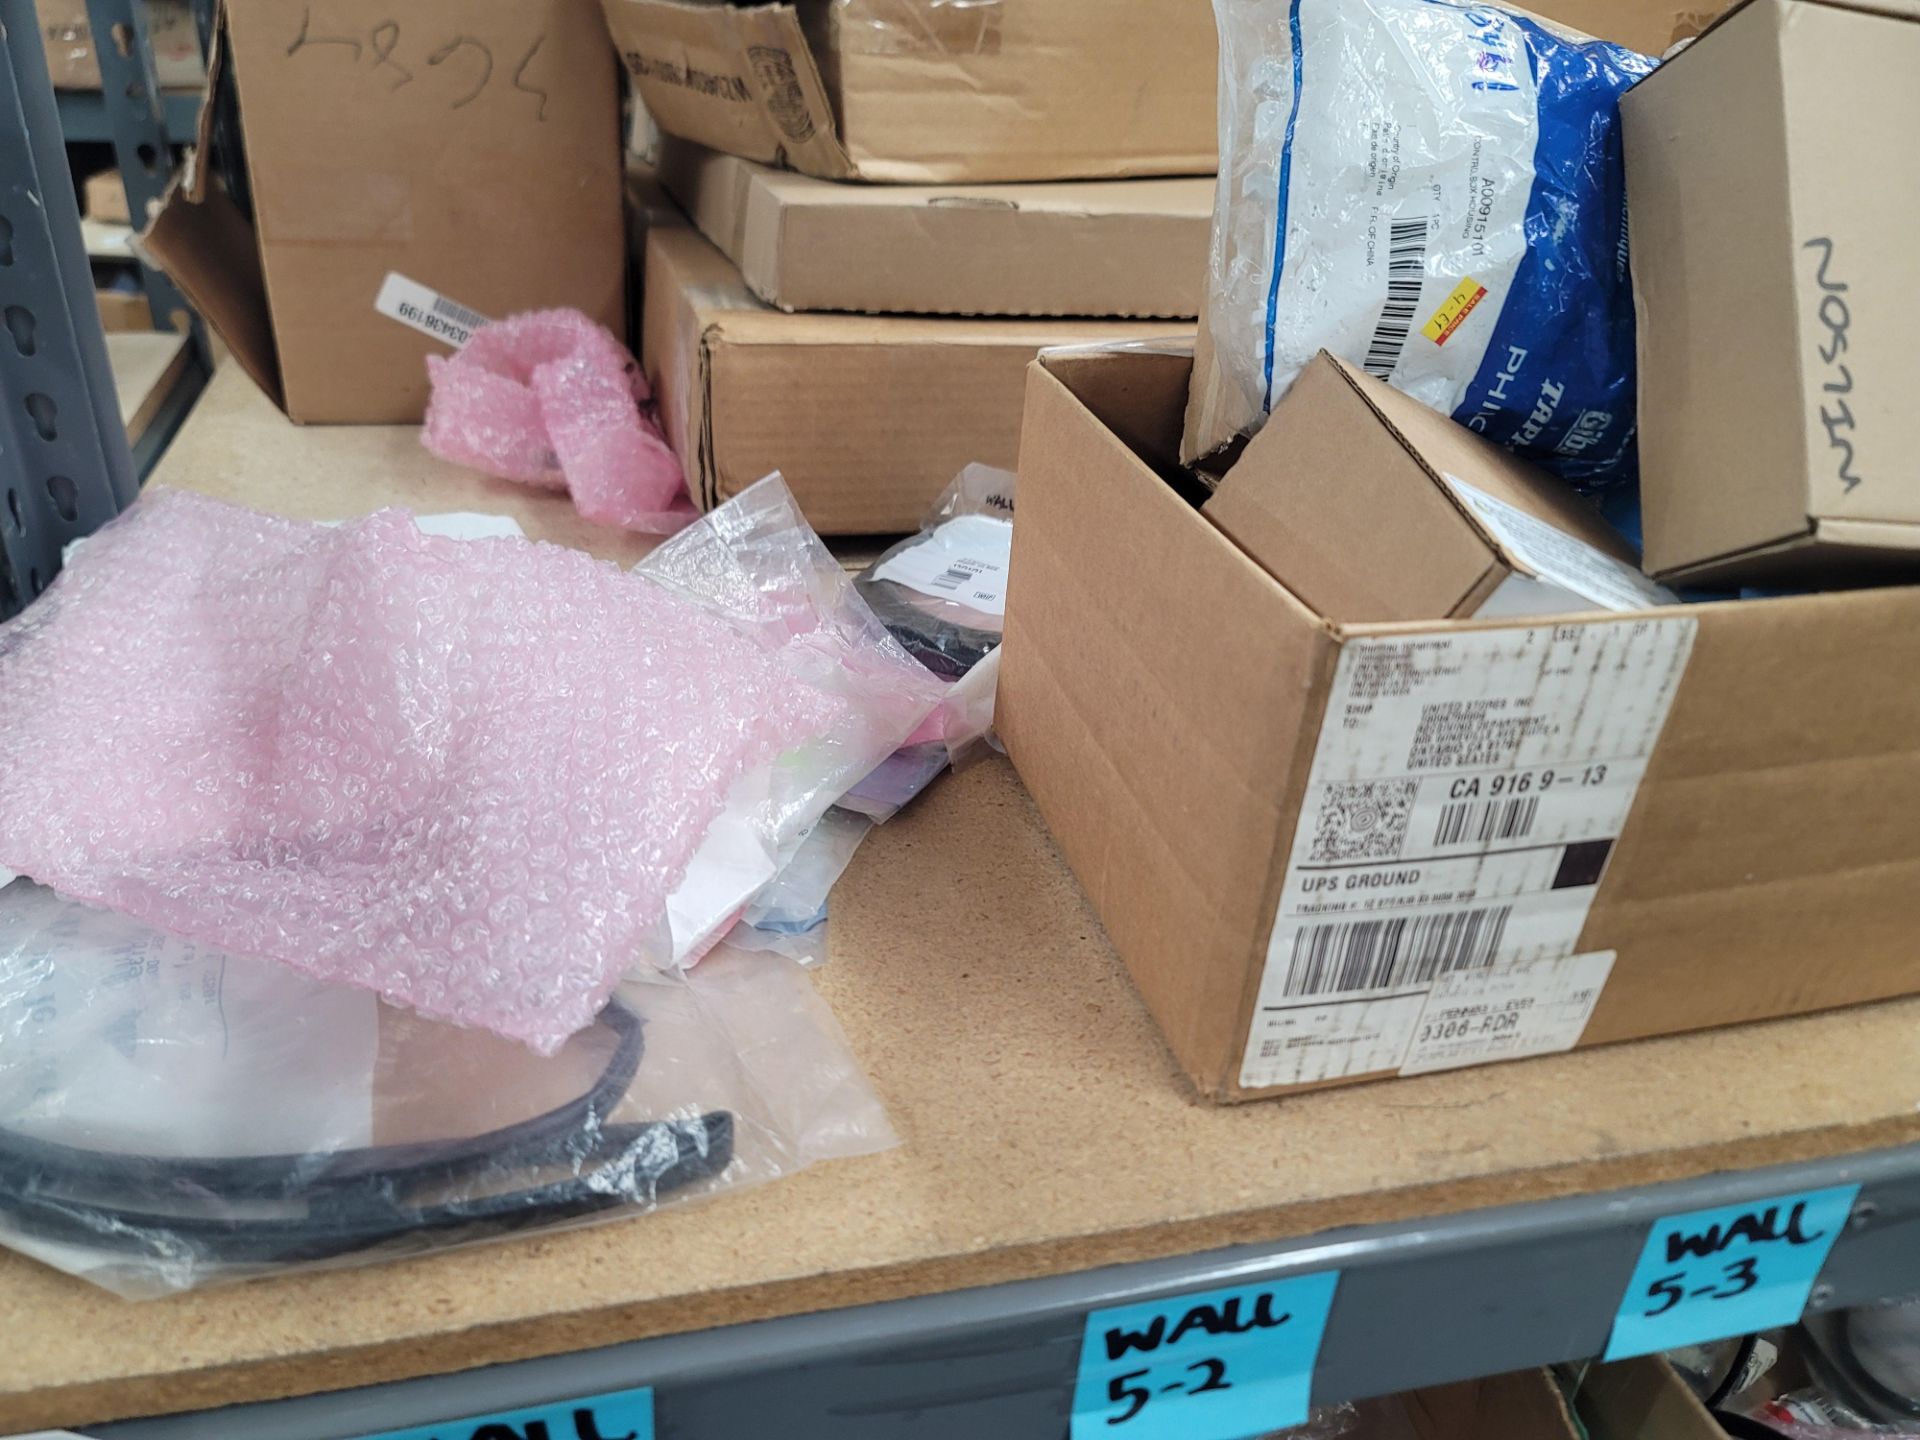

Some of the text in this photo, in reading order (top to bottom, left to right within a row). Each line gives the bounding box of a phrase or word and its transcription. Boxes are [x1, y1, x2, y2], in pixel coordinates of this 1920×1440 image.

[1387, 165, 1399, 190] Origin
[1450, 776, 1481, 799] CA
[1301, 869, 1421, 893] UPS GROUND
[1665, 1200, 1826, 1263] WALL
[1643, 1256, 1758, 1317] 5-3
[1104, 1292, 1293, 1361] WALL
[1106, 1357, 1234, 1425] 5-2
